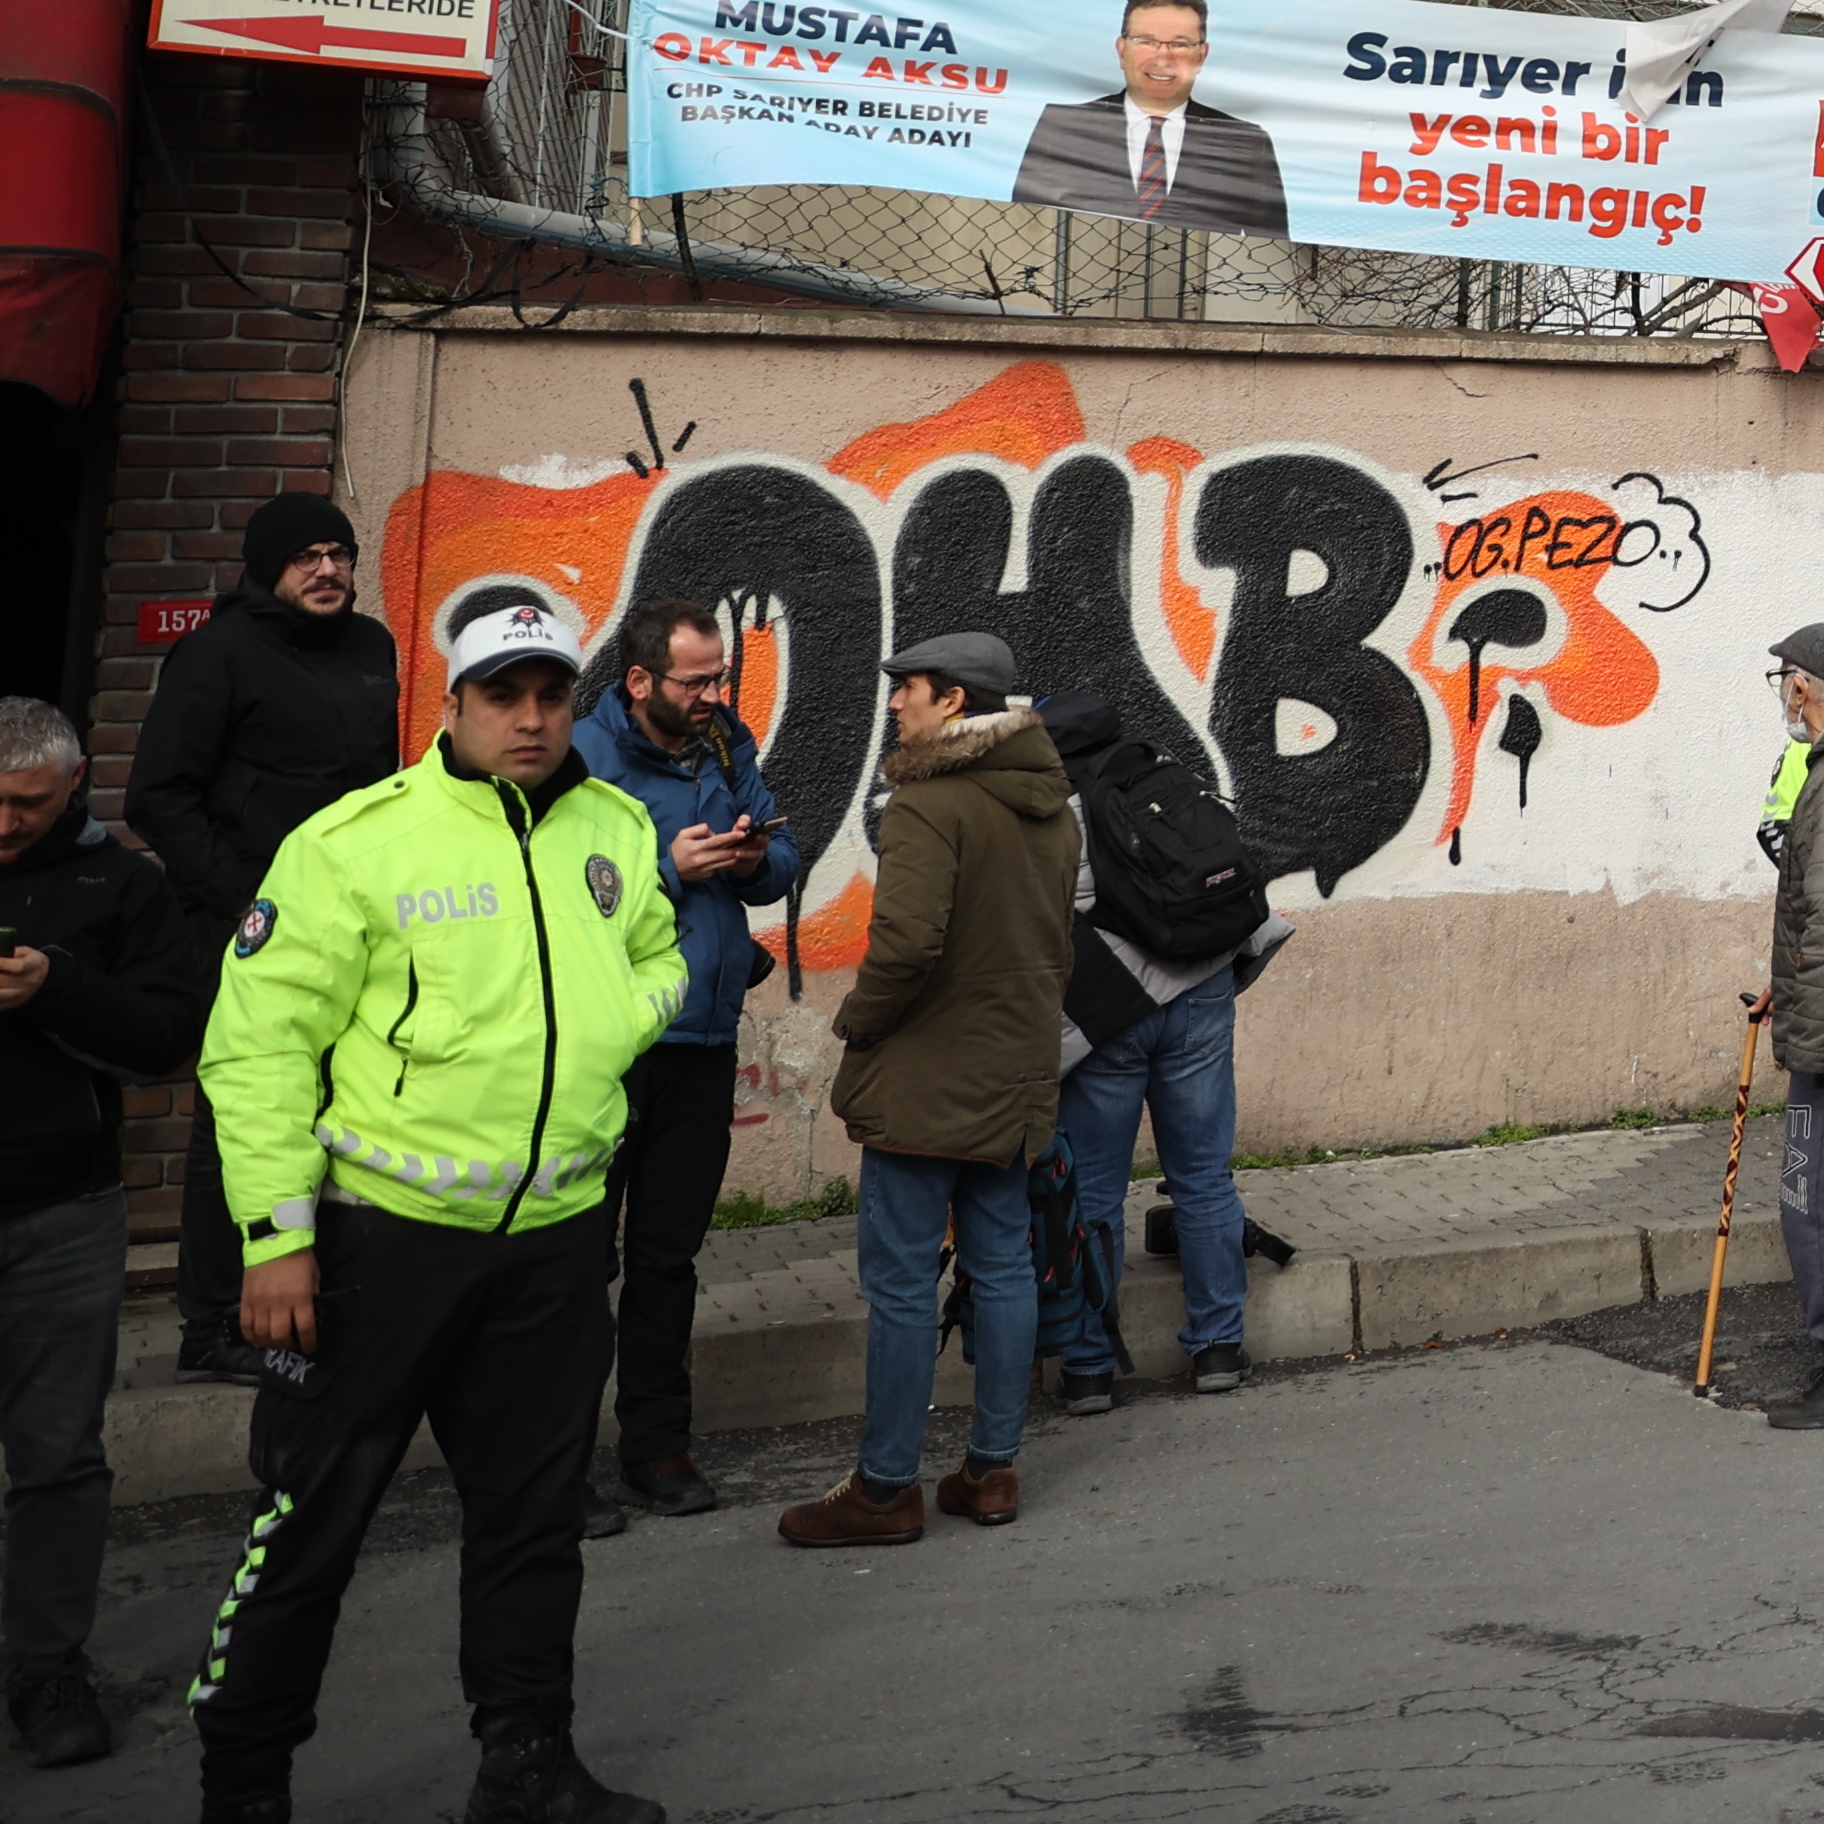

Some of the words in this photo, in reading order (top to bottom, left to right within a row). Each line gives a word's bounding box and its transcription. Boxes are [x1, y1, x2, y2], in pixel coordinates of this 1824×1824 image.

[653, 32, 842, 73] OKTAY
[861, 56, 1008, 94] AKSU
[1342, 31, 1591, 99] Sarıyer
[1608, 46, 1724, 107] in
[666, 82, 723, 99] CHP
[733, 88, 848, 116] SARIYER
[858, 101, 989, 125] BELEDİYE
[681, 105, 795, 125] BAŞKAN
[804, 119, 880, 140] ADAY
[886, 127, 972, 148] ADAYI
[1408, 105, 1558, 156] yeni
[1581, 111, 1669, 166] bir
[1357, 150, 1707, 246] başlangıç!
